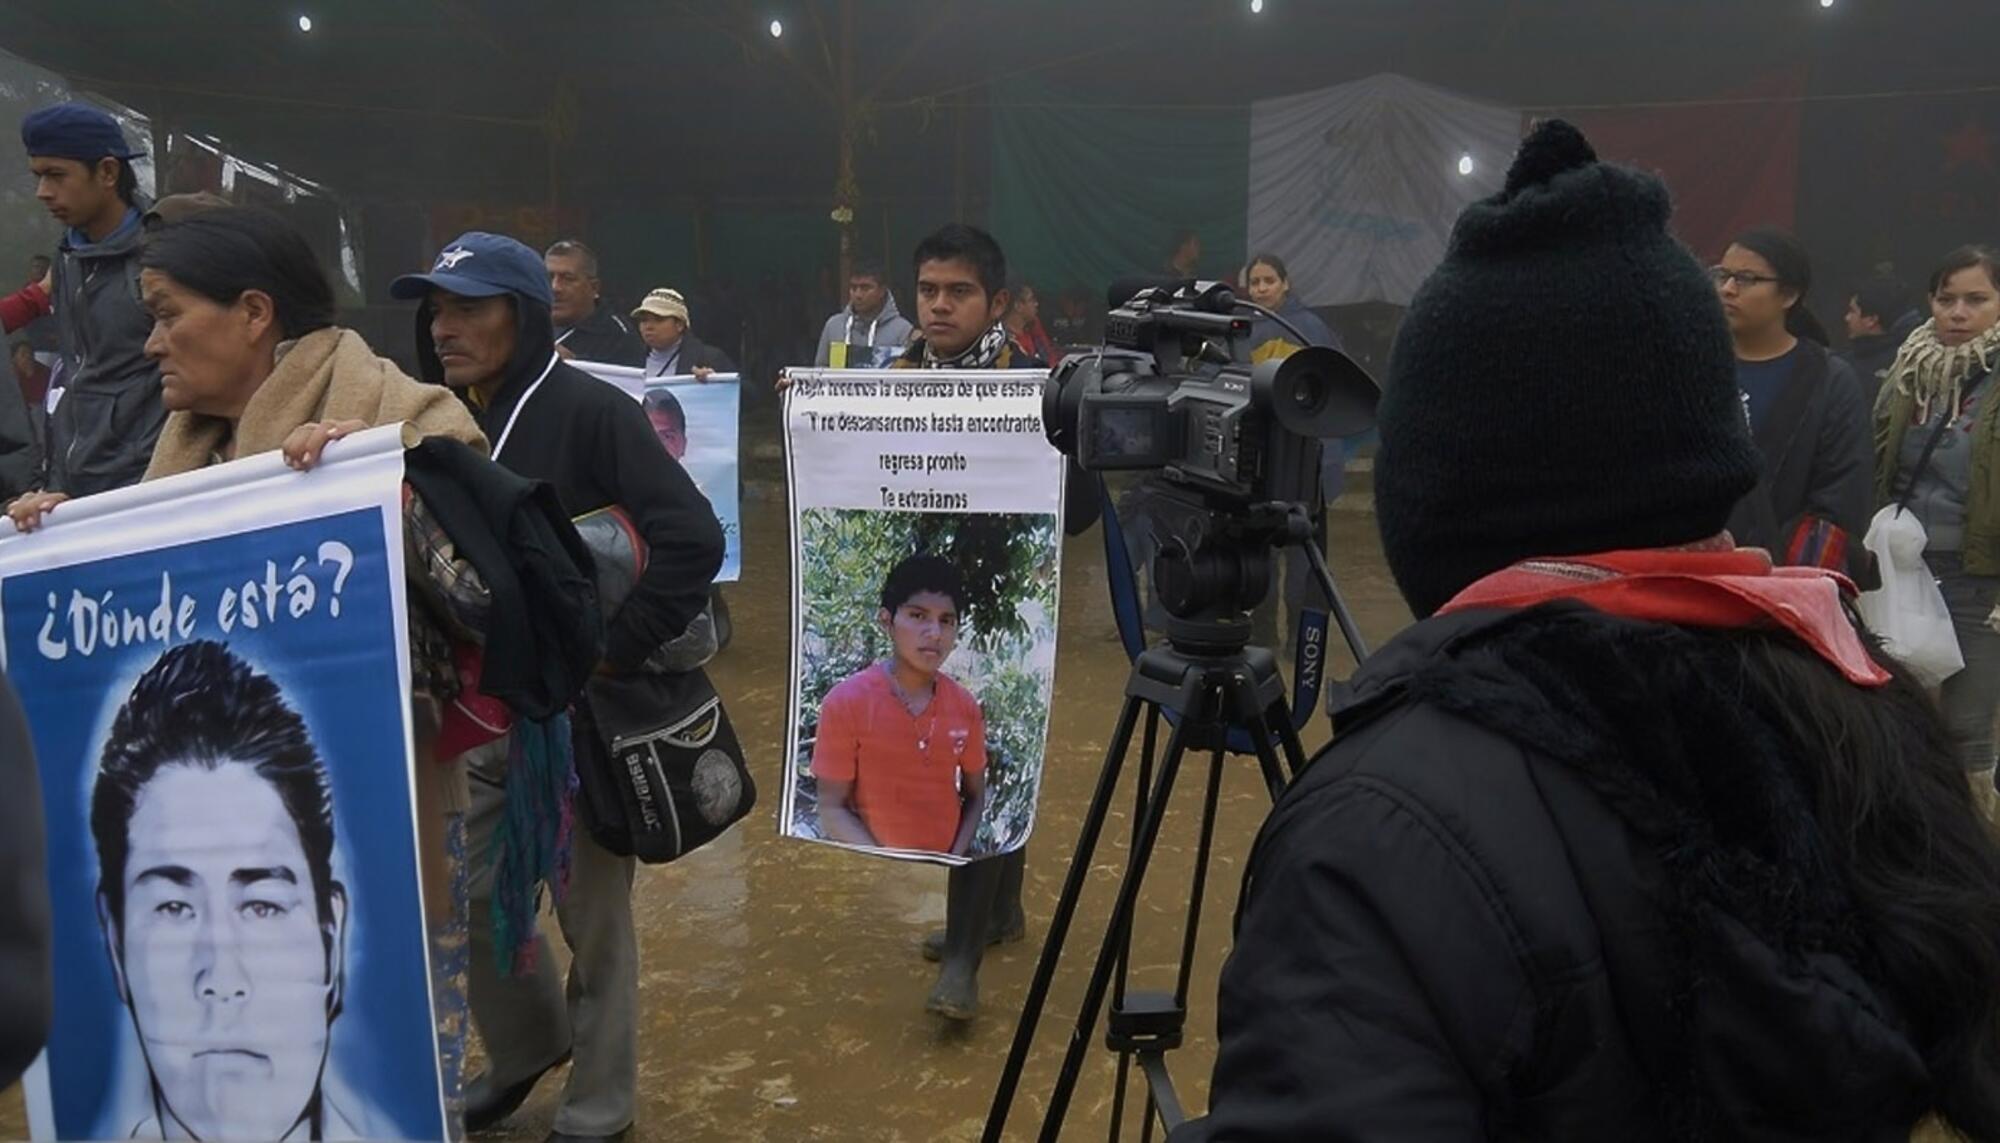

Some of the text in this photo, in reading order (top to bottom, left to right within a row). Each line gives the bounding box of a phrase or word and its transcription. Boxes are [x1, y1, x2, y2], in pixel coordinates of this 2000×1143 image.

[880, 379, 890, 397] la
[895, 381, 955, 401] esperanza
[957, 379, 972, 397] de
[976, 381, 998, 401] que
[822, 415, 835, 432] no
[838, 411, 927, 432] descansaremos
[931, 412, 963, 432] hasta
[968, 413, 1041, 432] encontrarte
[880, 452, 967, 475] regresa pronto
[880, 486, 895, 507] Te
[37, 540, 354, 660] ¿Dónde está?
[1302, 626, 1320, 688] SONY
